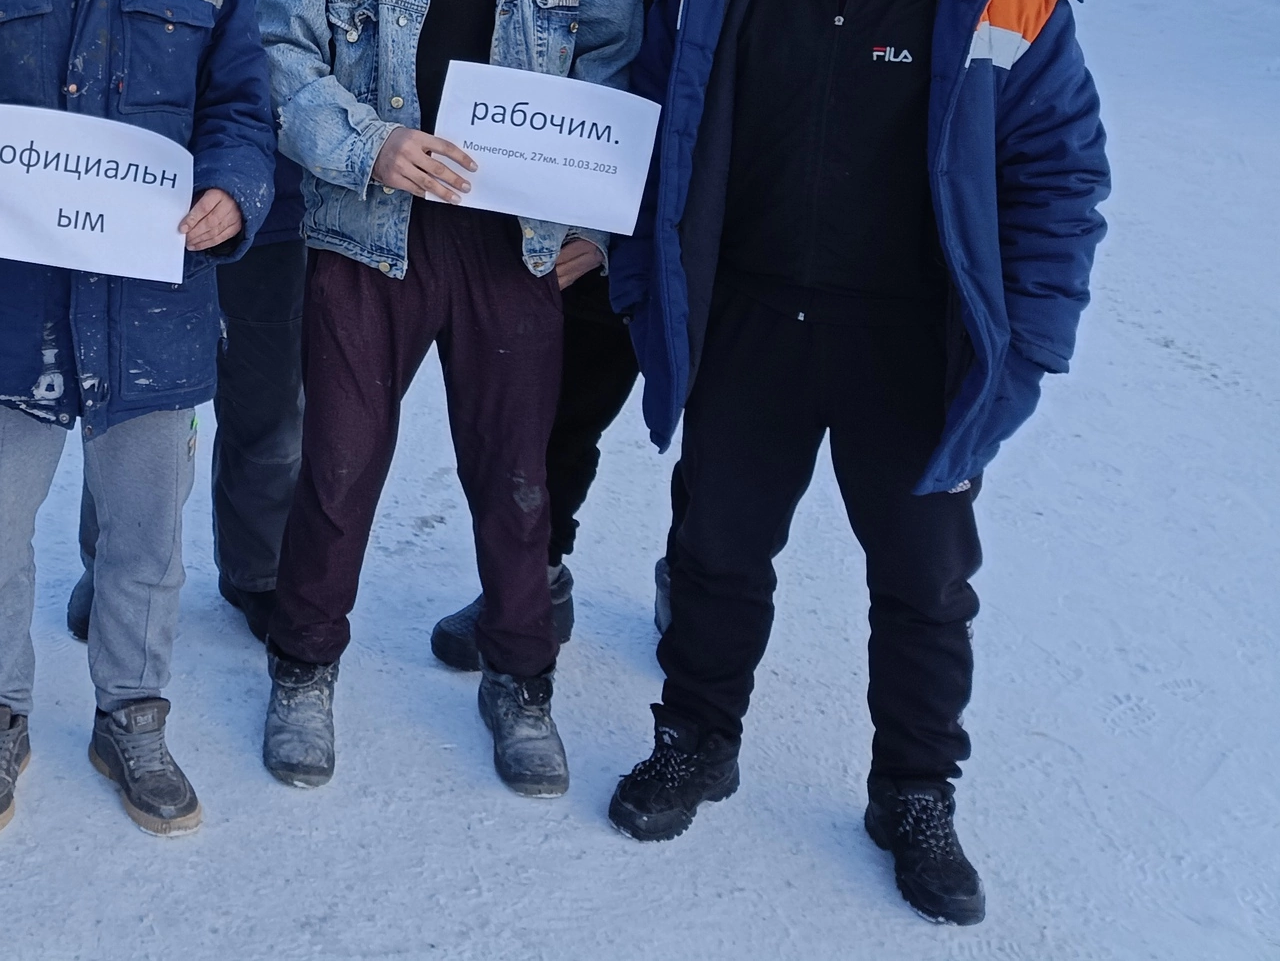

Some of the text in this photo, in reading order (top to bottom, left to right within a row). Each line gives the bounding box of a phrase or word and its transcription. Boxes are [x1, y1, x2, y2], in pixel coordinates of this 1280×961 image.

[873, 46, 913, 63] FILA
[470, 101, 620, 145] рабочим.
[0, 140, 178, 189] официальн
[463, 140, 618, 175] Мончегорск, 27км. 10.03.2023
[57, 208, 105, 233] ым
